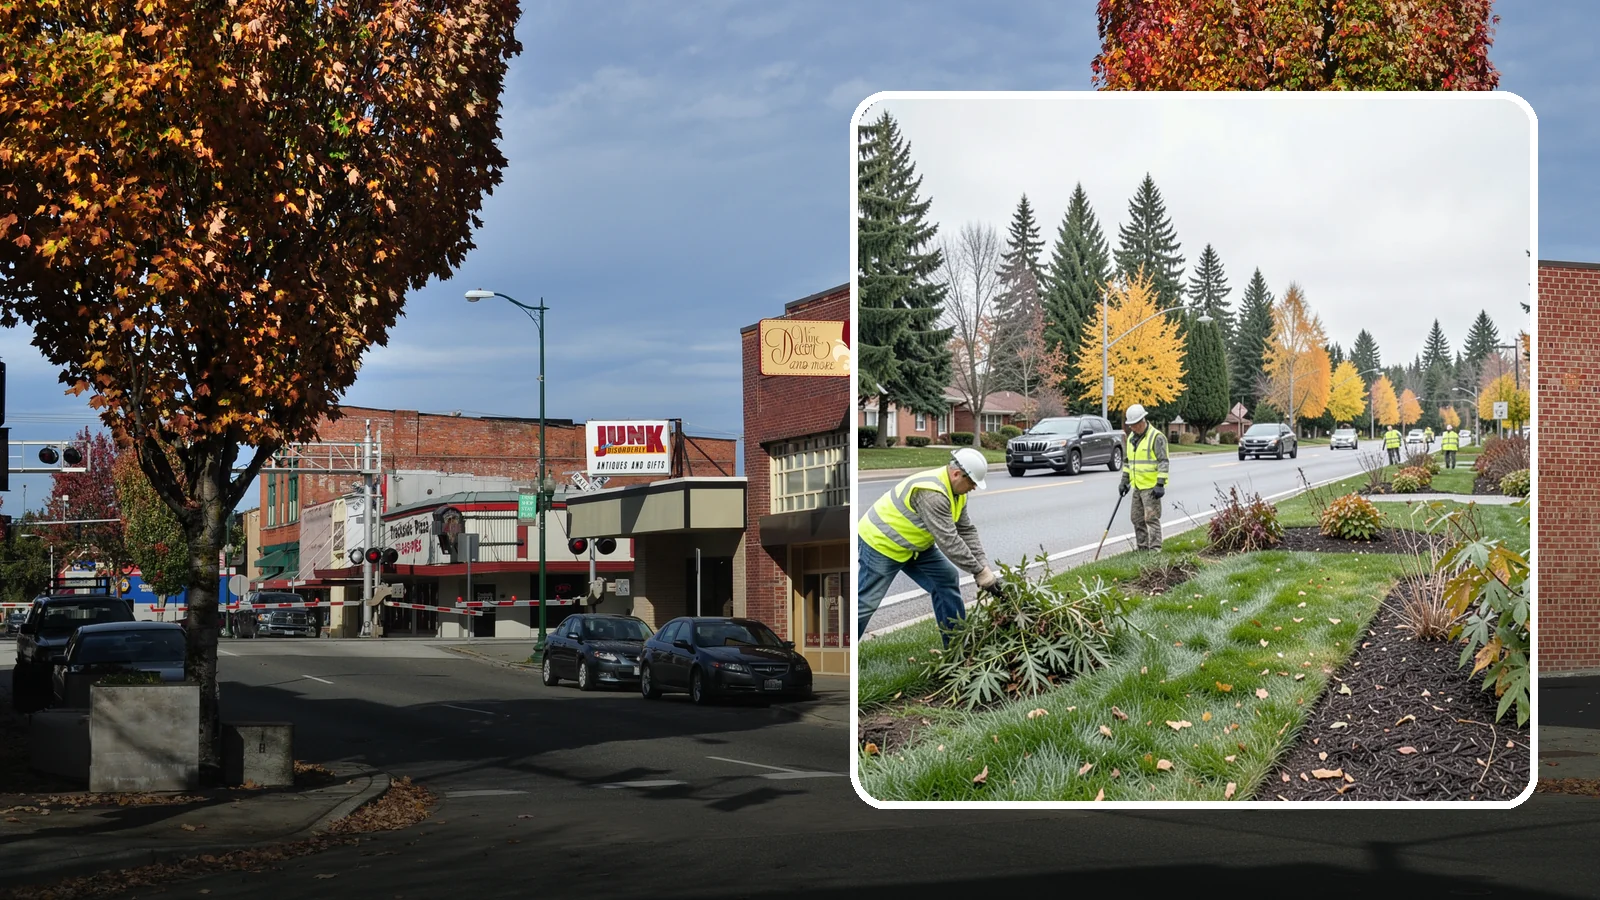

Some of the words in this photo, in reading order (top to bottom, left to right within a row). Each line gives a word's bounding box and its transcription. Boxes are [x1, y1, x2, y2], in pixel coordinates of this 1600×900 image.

[765, 327, 830, 365] Decor
[596, 425, 665, 457] JUNK
[608, 446, 645, 454] DISORDERLY
[597, 461, 628, 470] ANTIQUES
[631, 460, 643, 469] AND
[647, 460, 665, 469] GIFTS
[415, 519, 429, 534] Pizza
